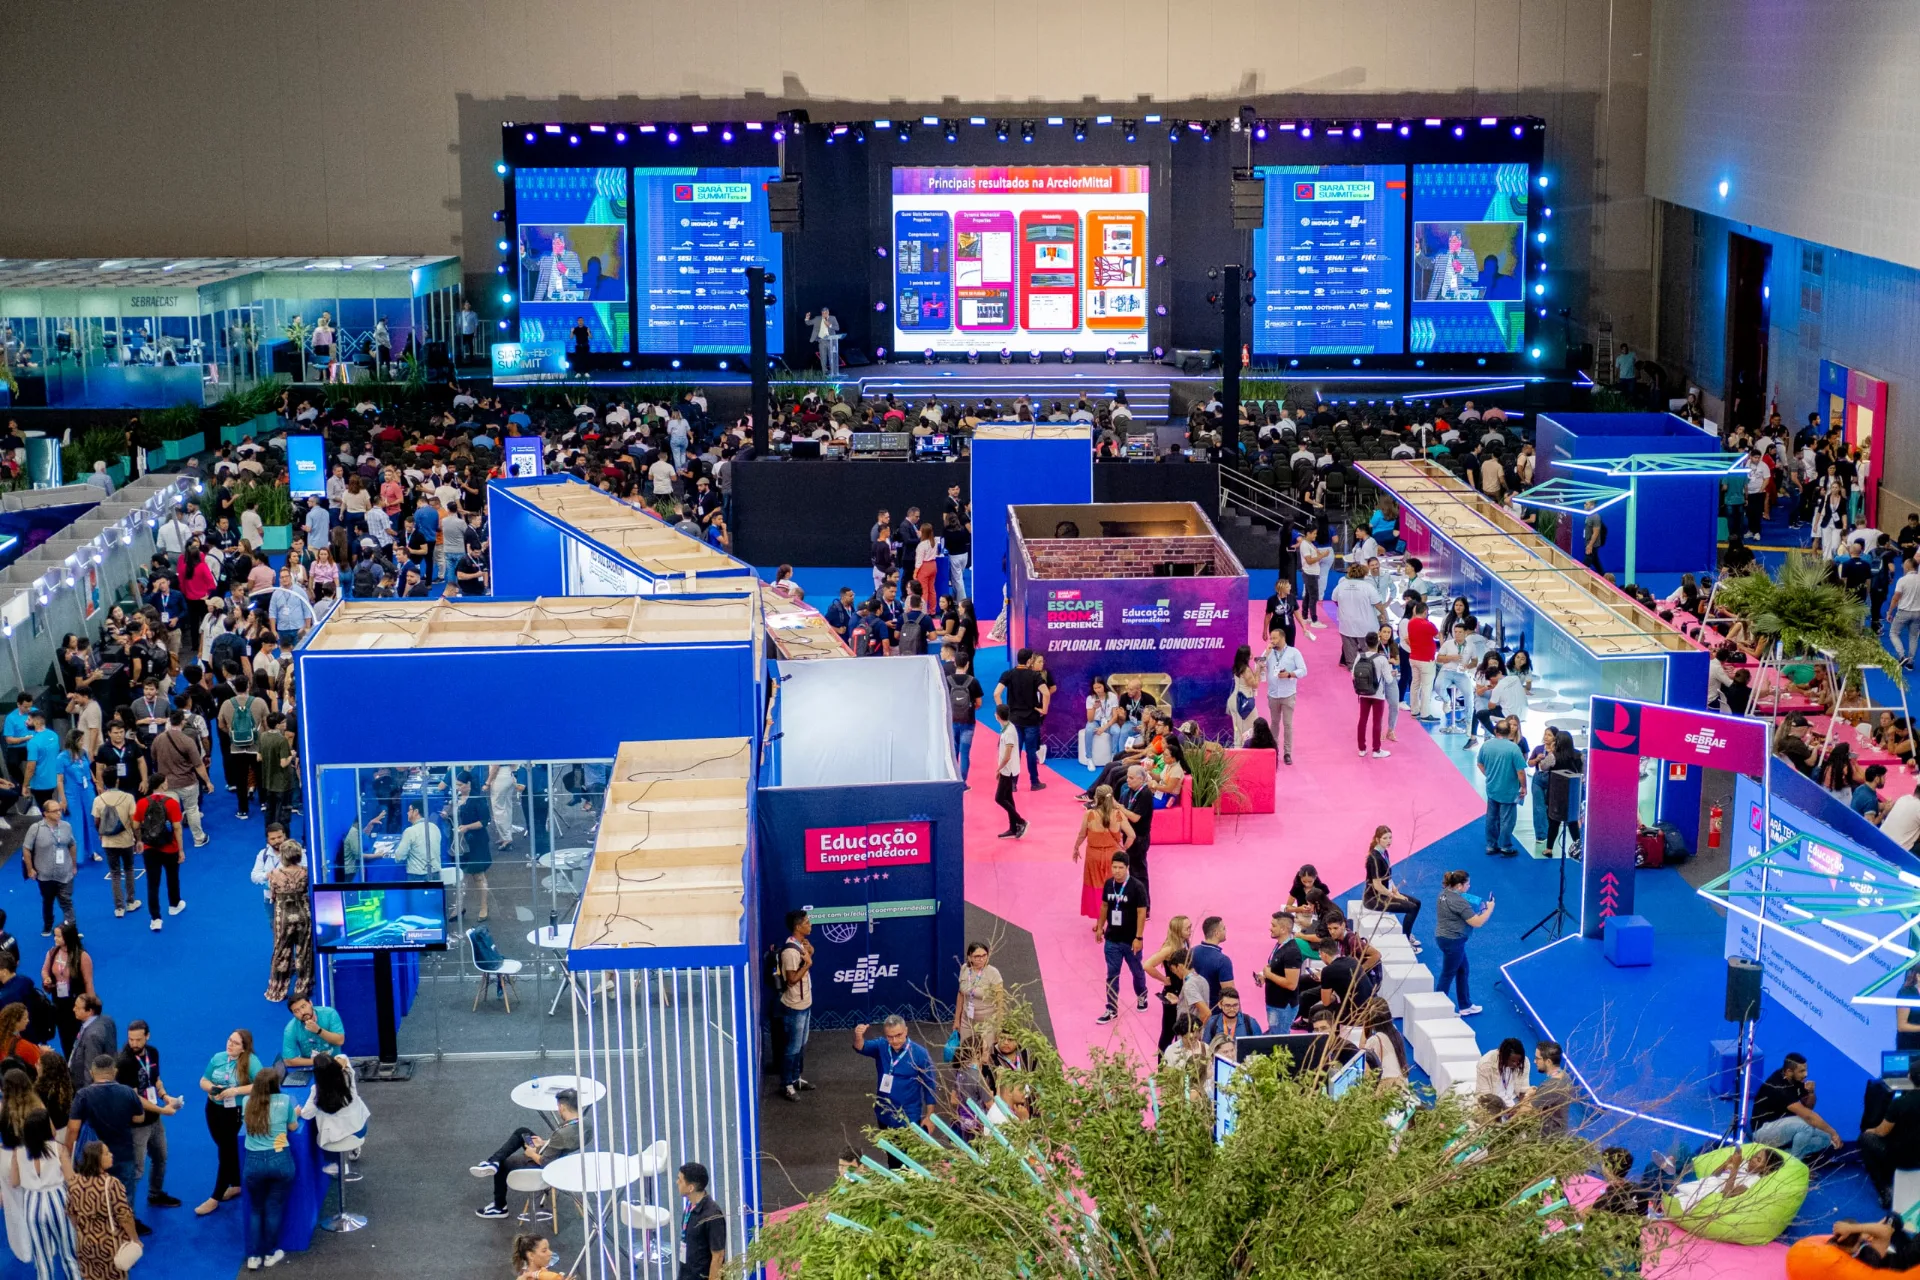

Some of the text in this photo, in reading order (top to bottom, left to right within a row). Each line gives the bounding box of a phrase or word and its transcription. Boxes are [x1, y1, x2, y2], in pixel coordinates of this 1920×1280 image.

[929, 176, 1112, 190] Principais resultados na ArcelorMittal
[498, 358, 541, 370] SUMMIT
[1048, 601, 1103, 611] ESCAPE
[1122, 608, 1170, 618] Educação
[1048, 611, 1091, 621] ROOM
[1183, 610, 1229, 619] SEBRAE
[1048, 637, 1225, 651] EXPLORAR. INSPIRAR. CONQUISTAR.
[1685, 734, 1726, 748] SEBRAE
[820, 828, 917, 850] Educação
[820, 846, 918, 864] Empreendedora
[1808, 840, 1844, 872] Educação
[833, 964, 899, 982] SEBRAE
